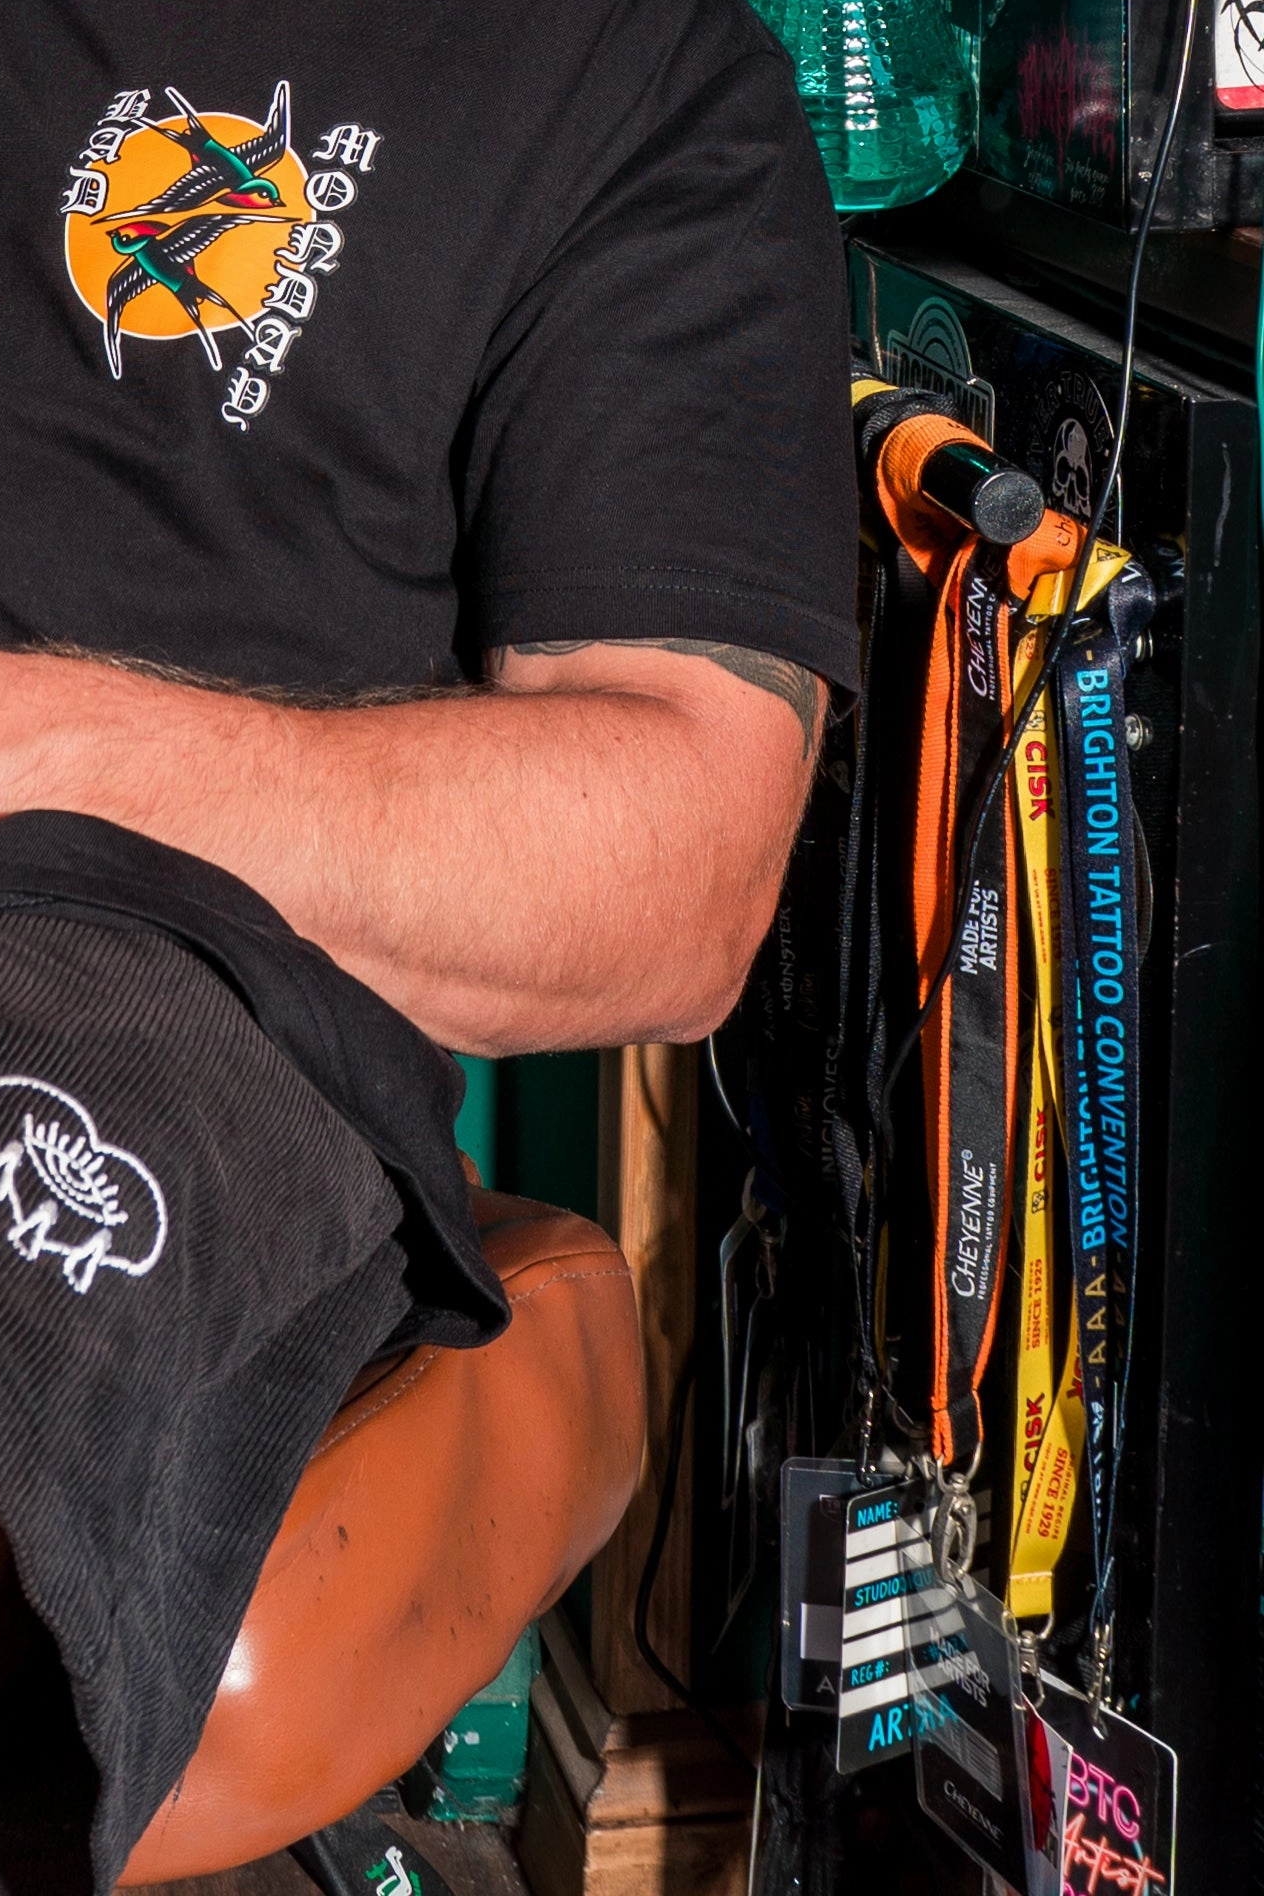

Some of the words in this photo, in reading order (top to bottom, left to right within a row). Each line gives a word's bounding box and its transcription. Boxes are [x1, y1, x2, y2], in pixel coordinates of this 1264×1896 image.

[966, 560, 1002, 698] CHEYENNE
[1025, 740, 1056, 822] CISK
[1076, 667, 1121, 857] BRIGHTON
[959, 919, 979, 975] MADE
[978, 888, 999, 971] ARTISTS
[1087, 865, 1124, 1005] TATTOO
[1034, 1110, 1046, 1182] CISK
[1094, 1014, 1128, 1248] CONVENTION
[984, 1209, 996, 1241] TATTOO
[1034, 1258, 1043, 1297] 1929
[1031, 1299, 1042, 1349] SINCE
[1023, 1392, 1045, 1473] CISK
[1045, 1446, 1068, 1503] SINCE
[856, 1500, 899, 1529] NAME:
[1038, 1505, 1055, 1538] 1929
[1051, 1505, 1065, 1540] RECIPE
[1067, 1750, 1141, 1842] BTC
[1063, 1812, 1166, 1896] Artist
